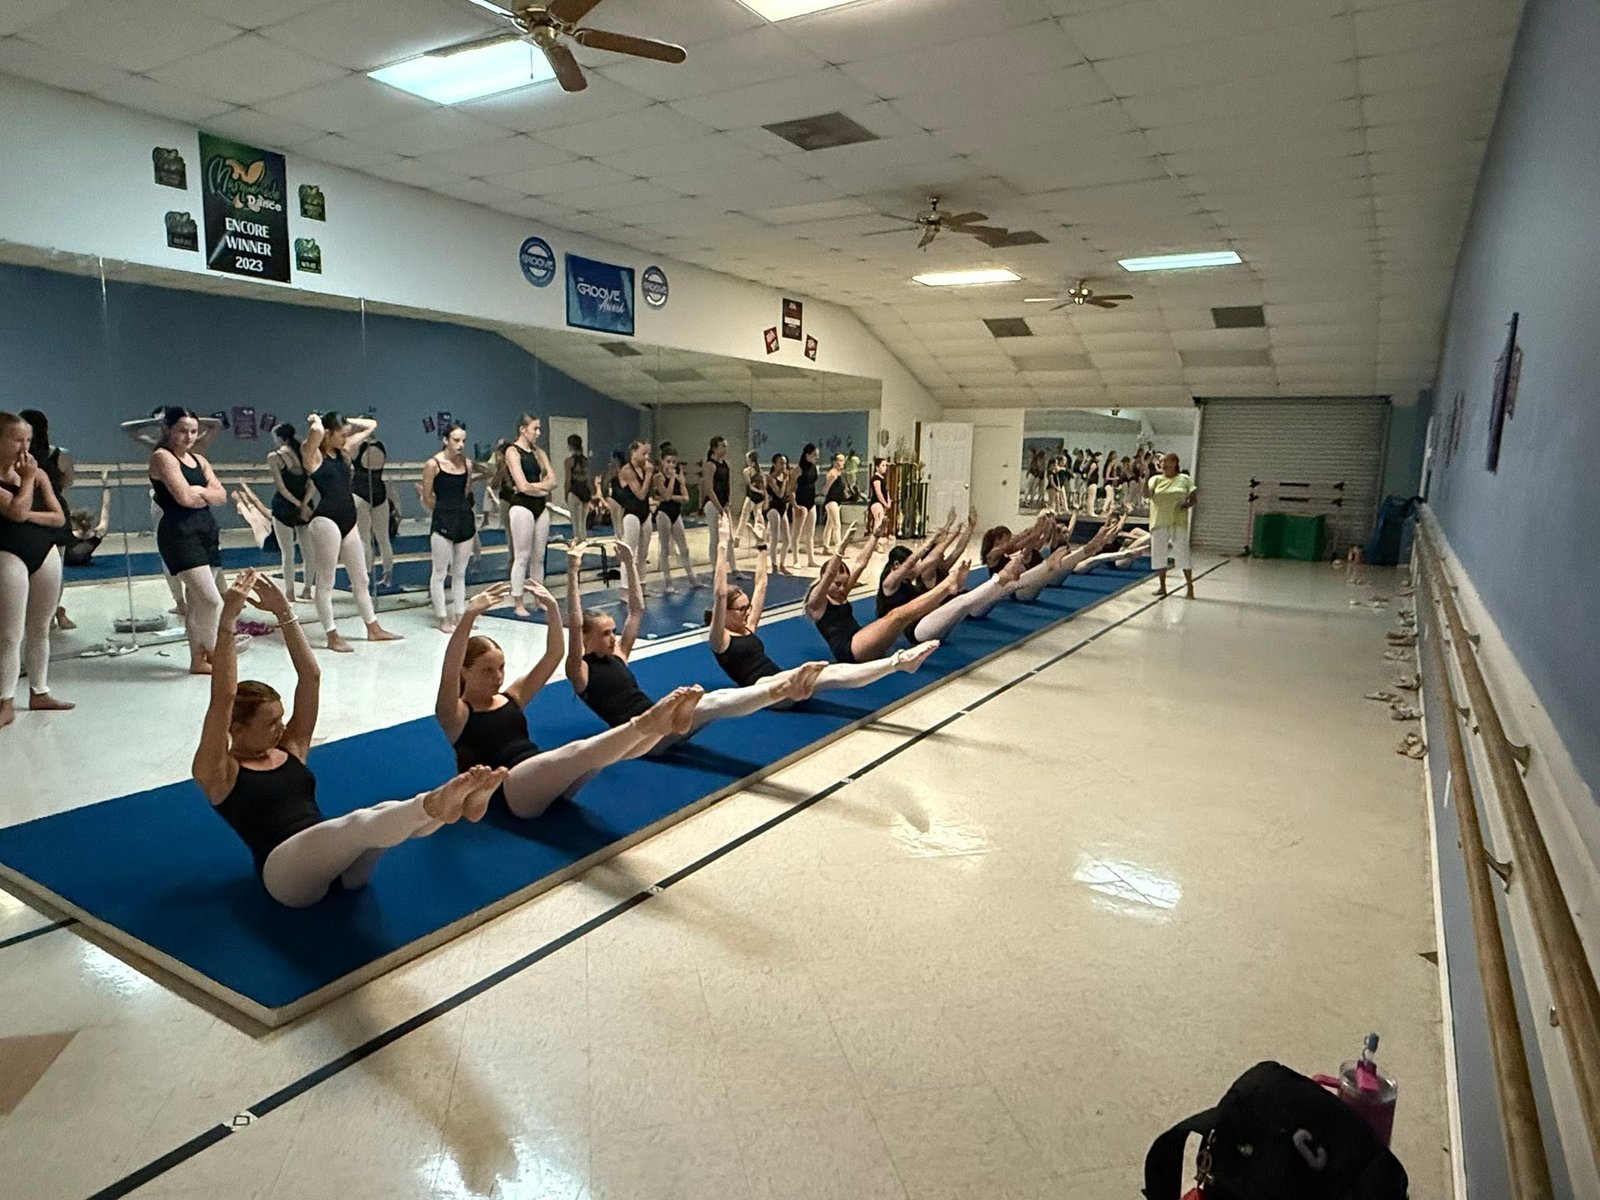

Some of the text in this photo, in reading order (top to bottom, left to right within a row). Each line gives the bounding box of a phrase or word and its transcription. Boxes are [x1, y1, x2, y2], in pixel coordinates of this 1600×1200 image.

[246, 195, 282, 212] Dance
[225, 217, 270, 238] ENCORE
[225, 236, 271, 256] WINNER
[235, 256, 264, 272] 2023
[577, 283, 621, 302] GROOVE
